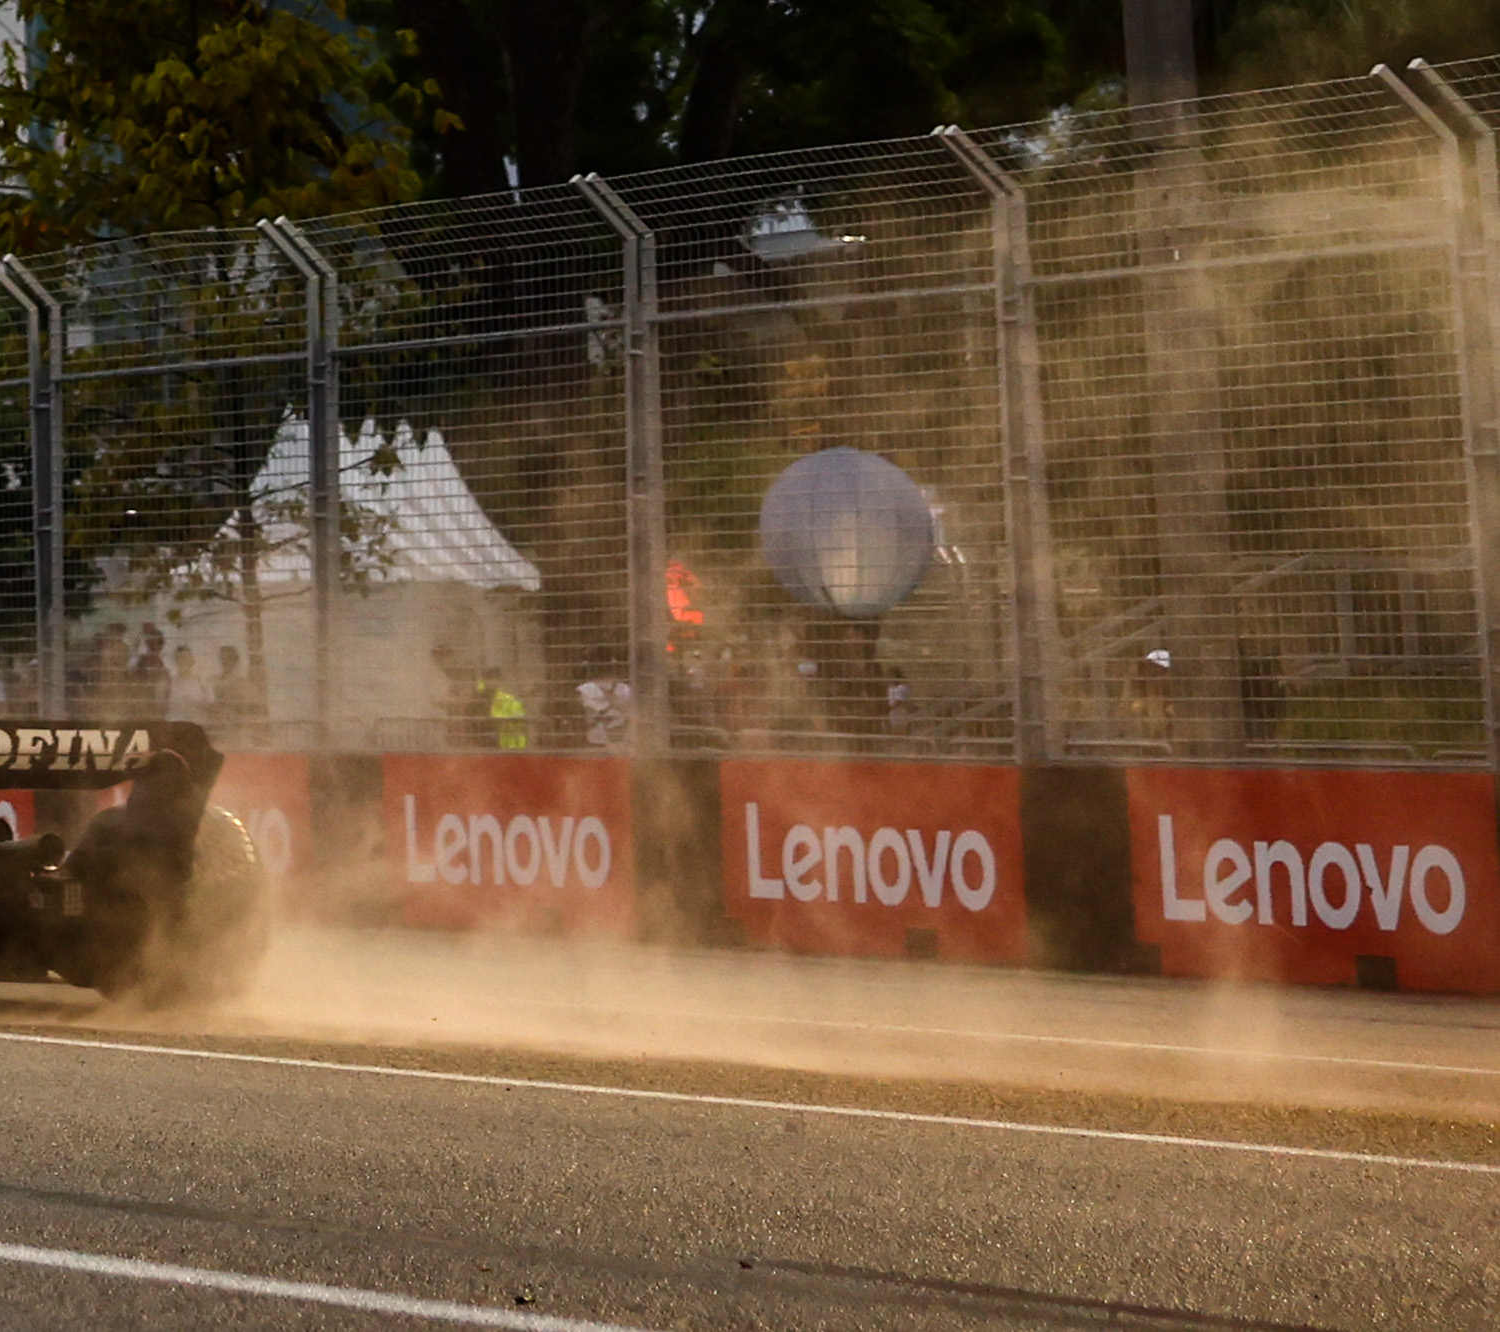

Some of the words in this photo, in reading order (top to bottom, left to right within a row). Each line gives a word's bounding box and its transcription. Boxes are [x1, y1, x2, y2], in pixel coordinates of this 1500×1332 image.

[404, 794, 611, 889] Lenovo
[745, 801, 996, 912] Lenovo
[1157, 813, 1467, 936] Lenovo
